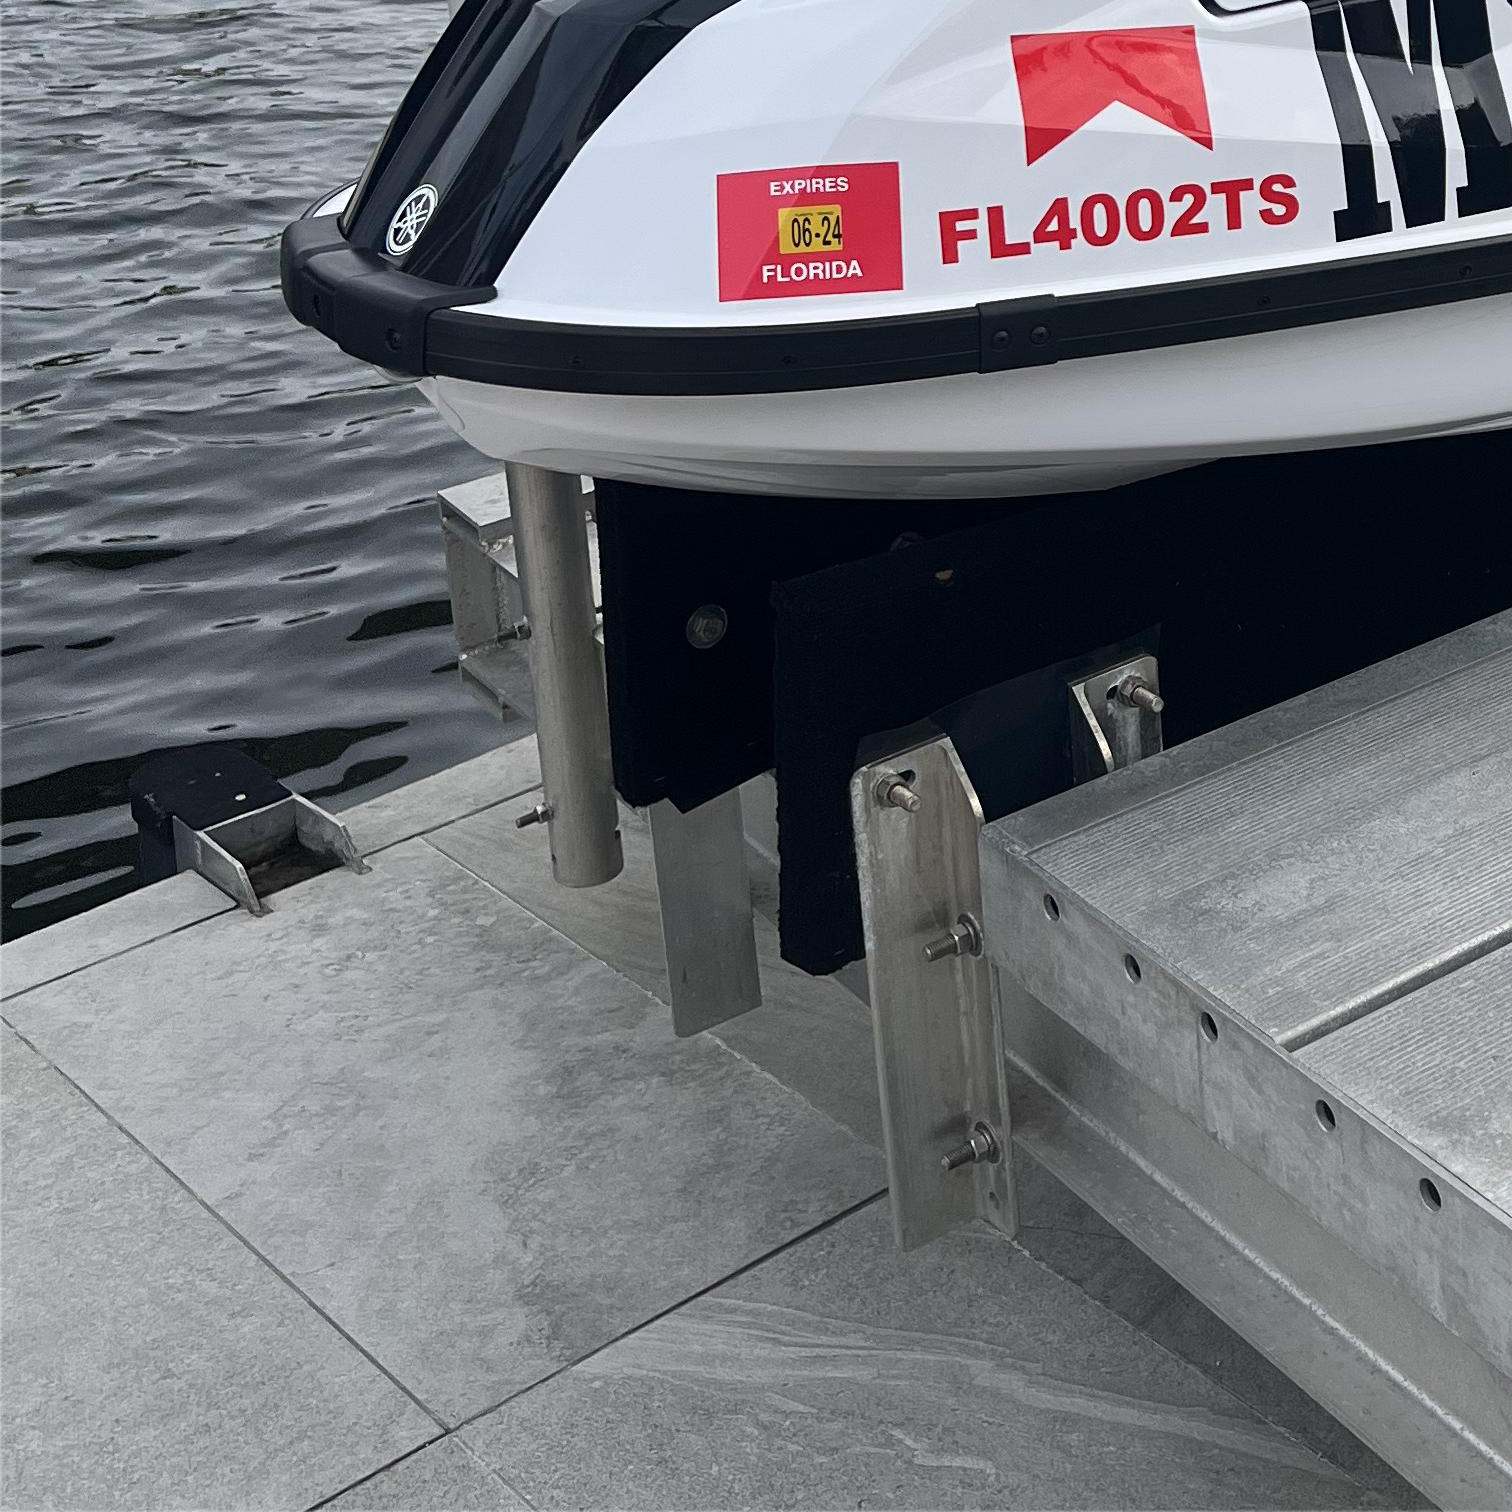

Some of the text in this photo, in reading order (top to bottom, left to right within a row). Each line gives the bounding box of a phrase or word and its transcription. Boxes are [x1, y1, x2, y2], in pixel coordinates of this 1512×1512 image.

[769, 176, 850, 197] EXPIRES
[791, 214, 843, 248] 06-24
[937, 173, 1300, 265] FL4002TS
[761, 260, 864, 285] FLORIDA
